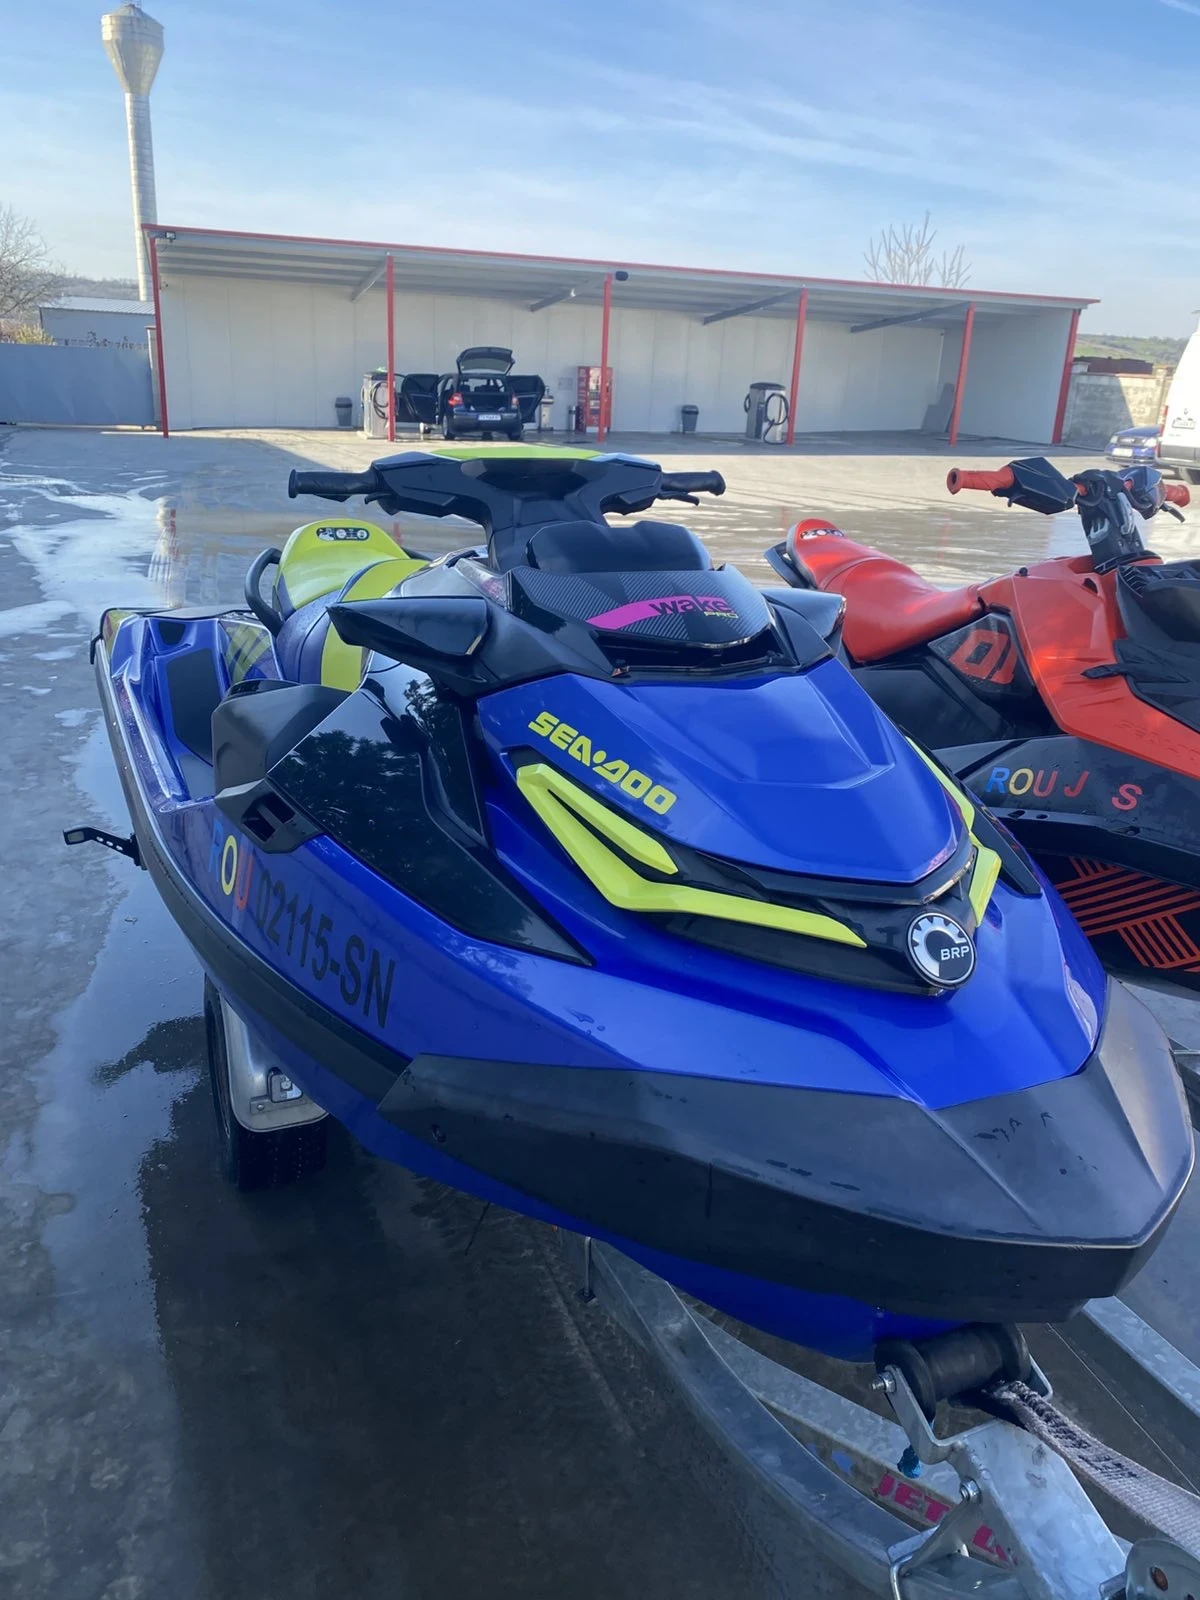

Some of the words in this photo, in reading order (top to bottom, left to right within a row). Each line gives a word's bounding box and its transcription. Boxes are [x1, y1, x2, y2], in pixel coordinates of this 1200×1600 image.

[649, 595, 734, 615] wake
[704, 611, 739, 619] PRO
[985, 766, 1058, 798] ROU
[1111, 783, 1143, 811] S
[208, 818, 254, 911] ROU
[256, 868, 396, 1029] 02115-SN
[940, 945, 970, 961] BRP
[872, 1472, 951, 1525] JET
